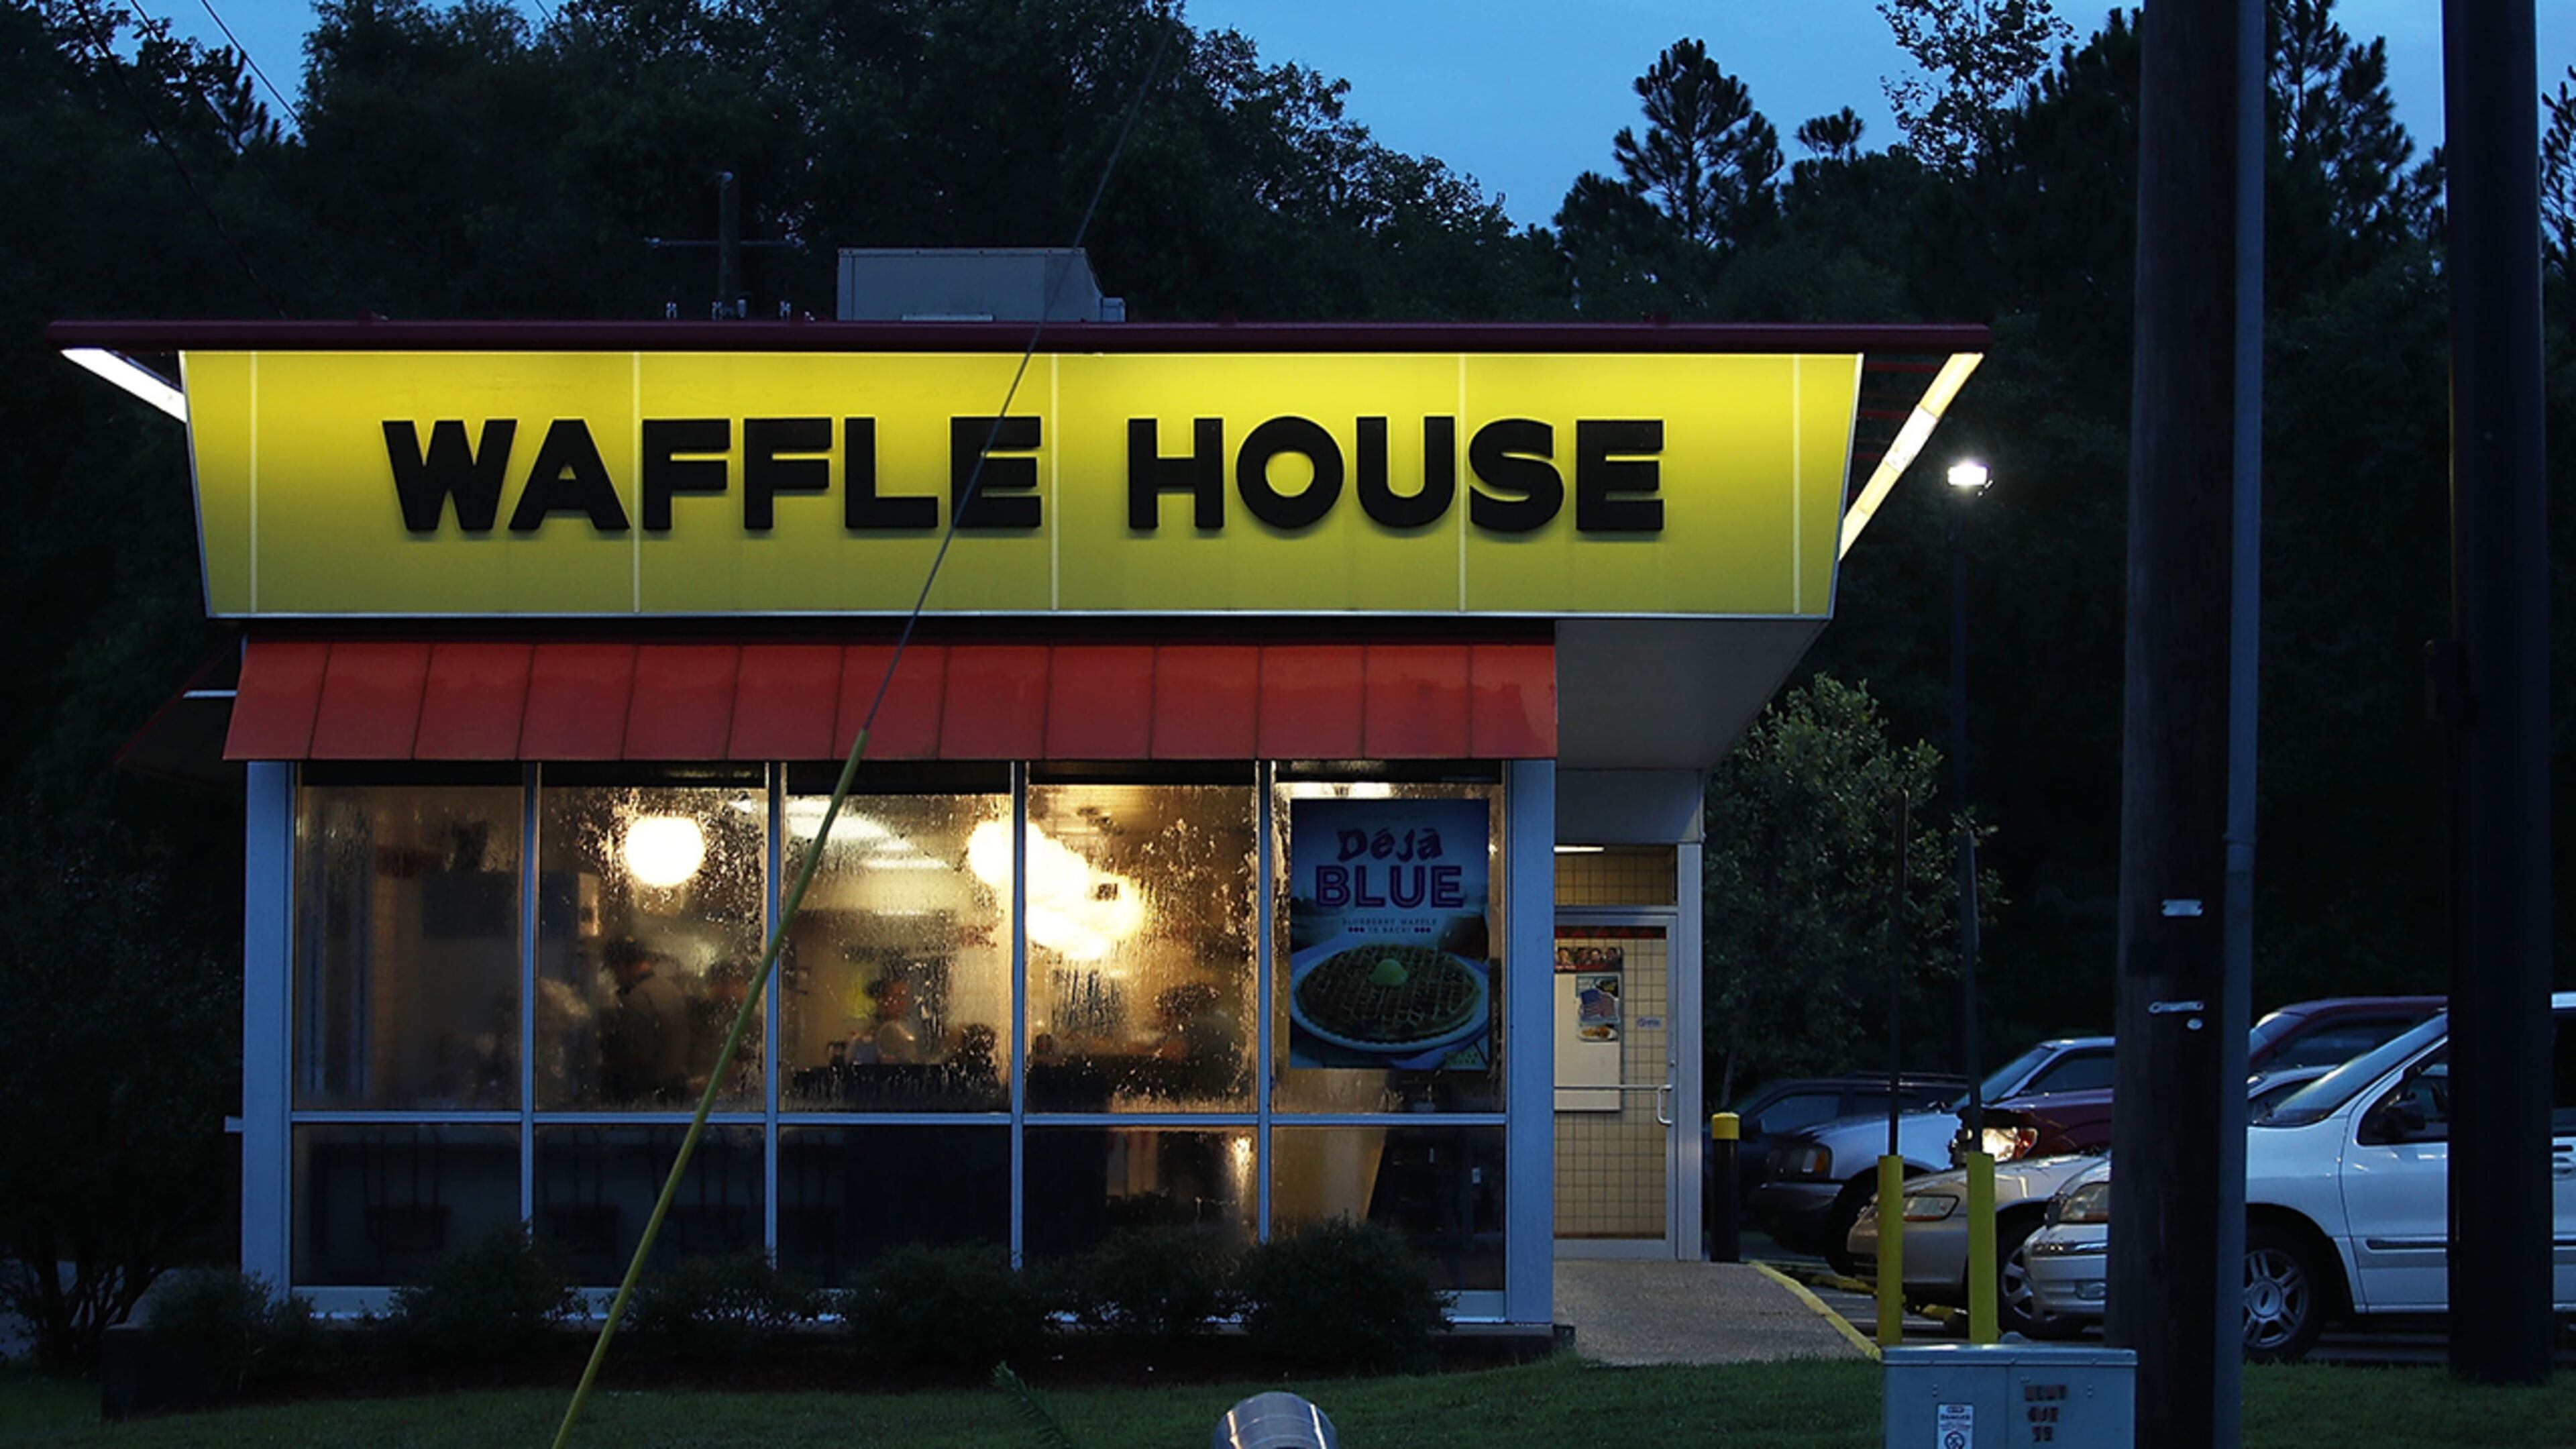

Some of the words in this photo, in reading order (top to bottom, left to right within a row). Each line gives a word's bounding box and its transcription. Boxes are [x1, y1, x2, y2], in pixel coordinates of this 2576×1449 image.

[382, 416, 1041, 531] WAFFLE
[1128, 416, 1664, 532] HOUSE
[1316, 865, 1463, 908] BLUE
[1400, 917, 1437, 925] WAFFLE
